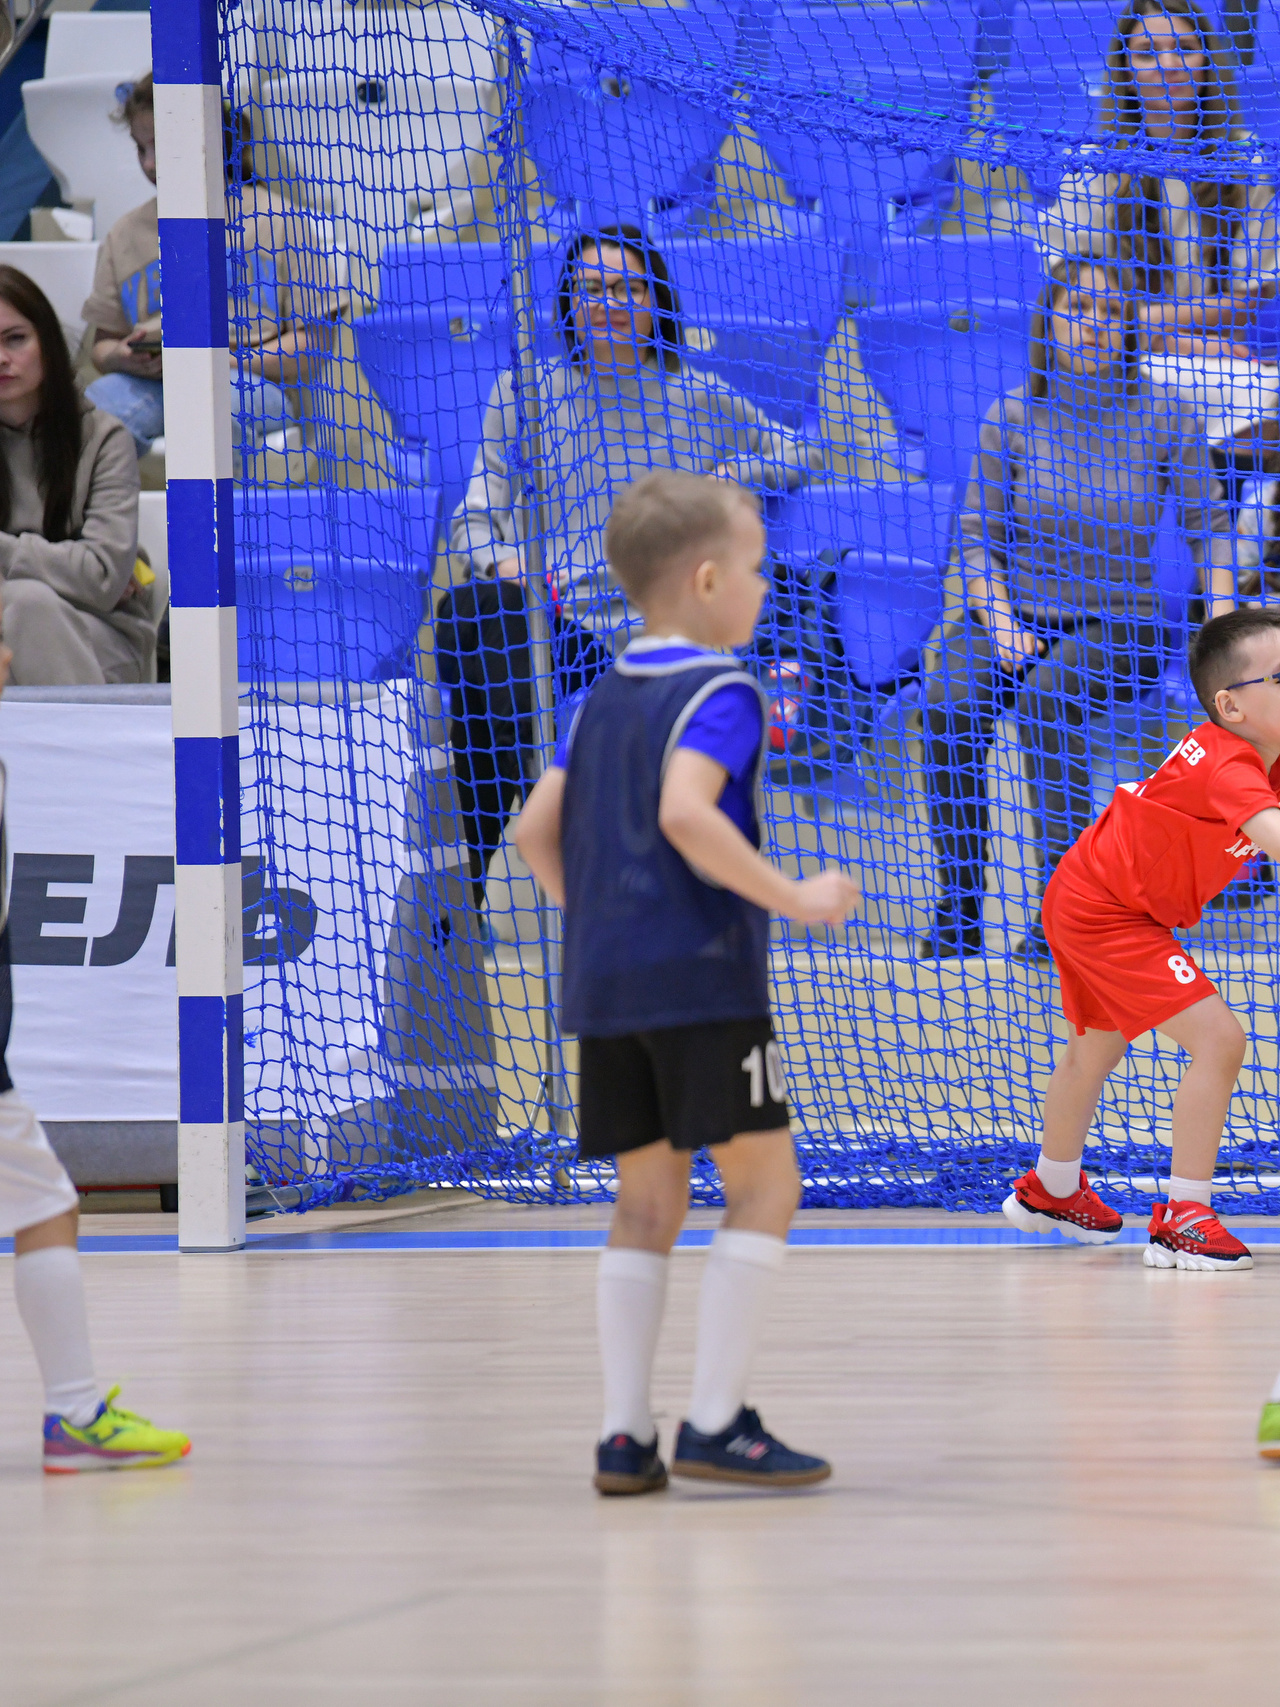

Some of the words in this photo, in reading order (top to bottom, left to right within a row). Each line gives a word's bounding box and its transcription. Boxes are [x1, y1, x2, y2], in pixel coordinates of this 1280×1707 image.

[1179, 735, 1207, 767] ЕВ
[1167, 954, 1197, 985] 8
[741, 1040, 786, 1108] 10
